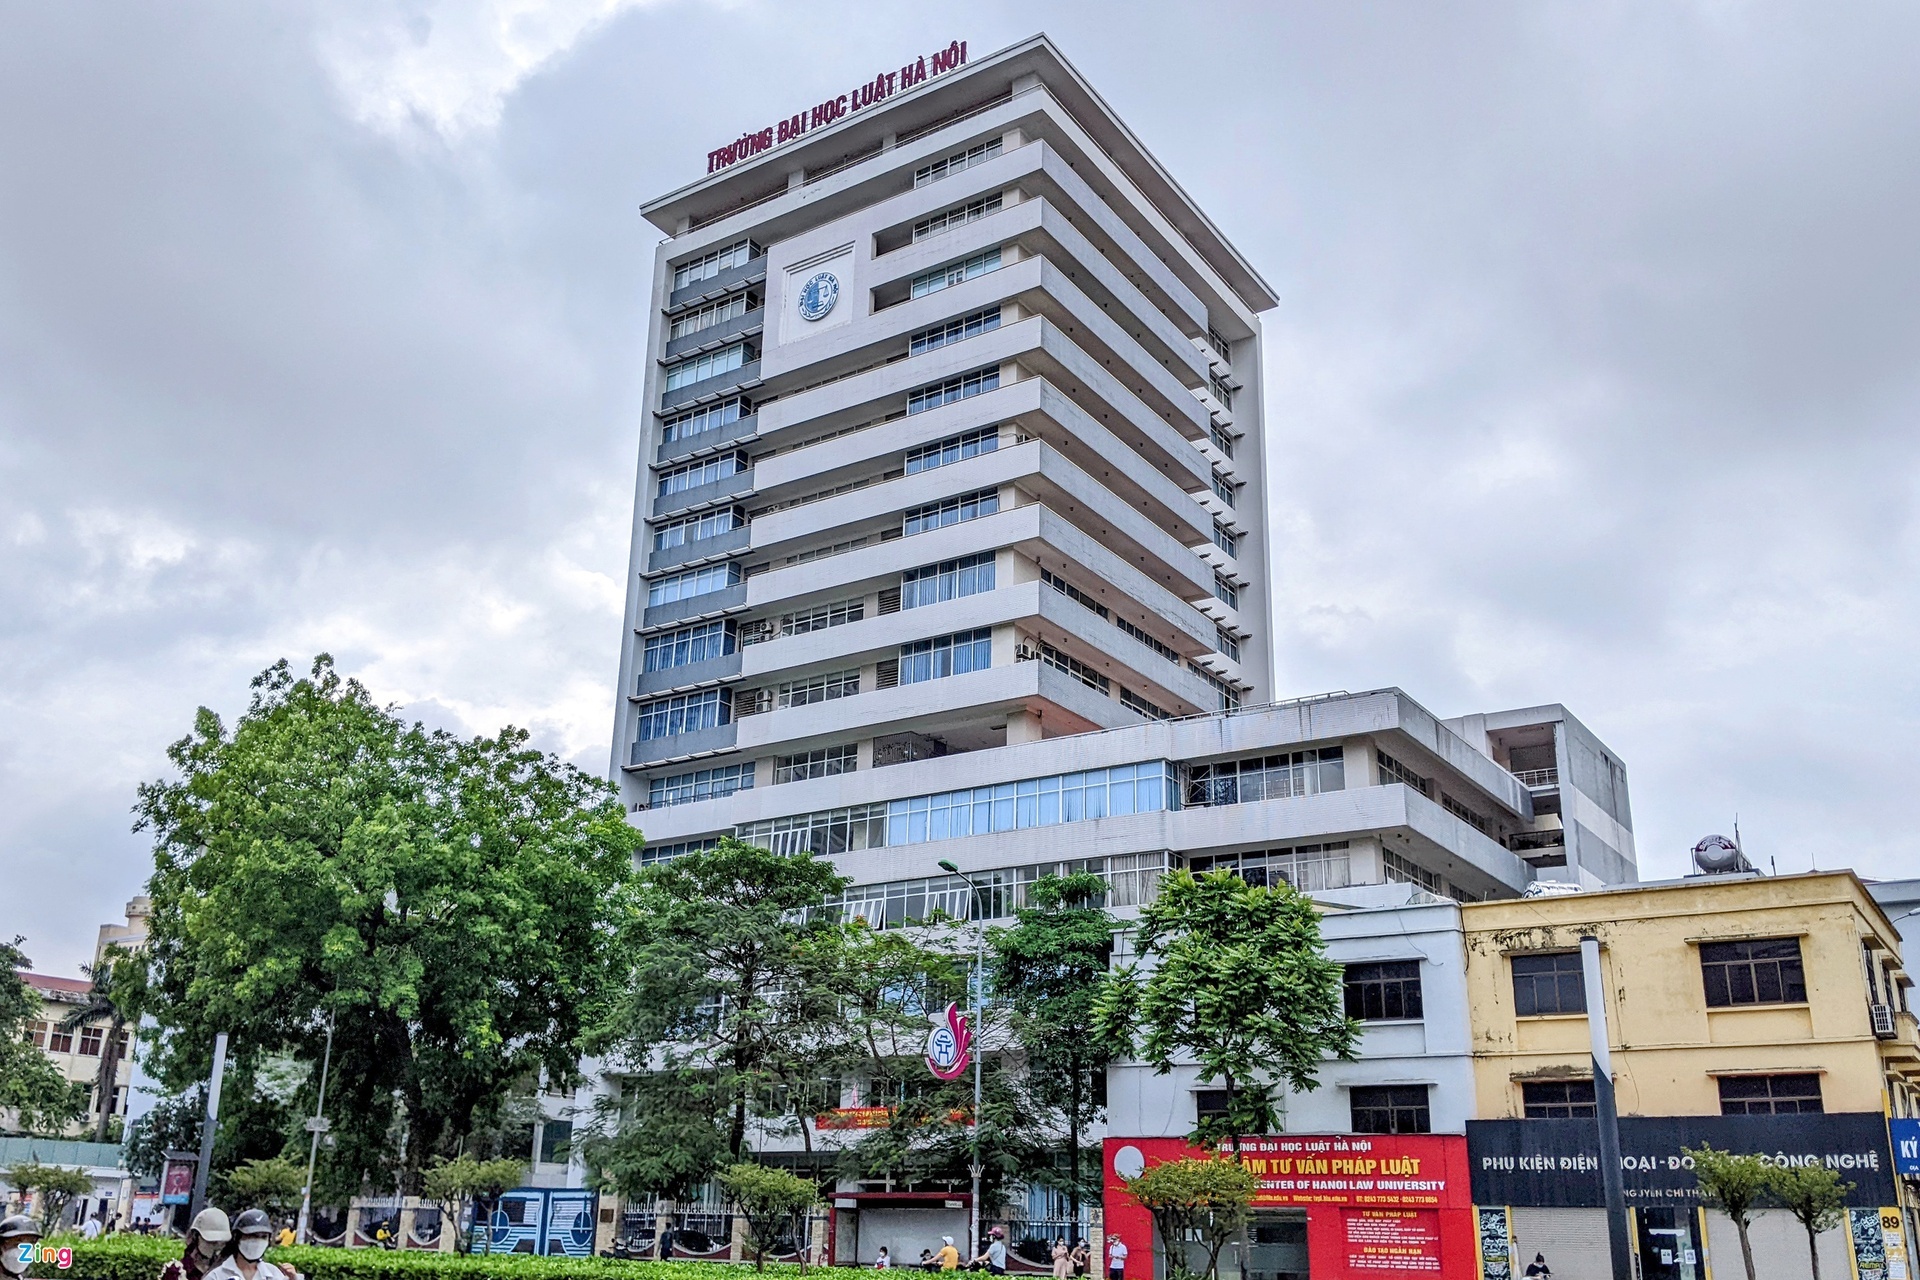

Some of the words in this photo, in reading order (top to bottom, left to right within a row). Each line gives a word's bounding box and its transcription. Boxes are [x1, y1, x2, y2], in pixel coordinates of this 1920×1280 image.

[707, 132, 773, 173] TRƯỜNG
[811, 95, 847, 125] HỌC
[901, 55, 927, 90] HÀ
[1260, 1142, 1278, 1153] ĐẠI
[1281, 1142, 1302, 1153] HỌC
[1305, 1140, 1331, 1153] LUẬT
[1352, 1140, 1372, 1153] NỘI
[1900, 1136, 1918, 1158] KÝ
[1238, 1155, 1267, 1174] ÂM
[1270, 1158, 1293, 1175] TƯ
[1296, 1153, 1328, 1175] VẤN
[1332, 1156, 1377, 1175] PHÁP
[1380, 1155, 1421, 1178] LUẬT
[1482, 1156, 1515, 1174] PHỤ
[1519, 1153, 1556, 1174] KIỆN
[1559, 1153, 1599, 1174] ĐIỆN
[1825, 1149, 1879, 1172] NGHỆ
[1296, 1180, 1310, 1190] OF
[1312, 1180, 1347, 1190] HANOI
[1349, 1181, 1374, 1191] LAW
[1376, 1181, 1446, 1191] UNIVERSITY
[1881, 1216, 1900, 1229] 89
